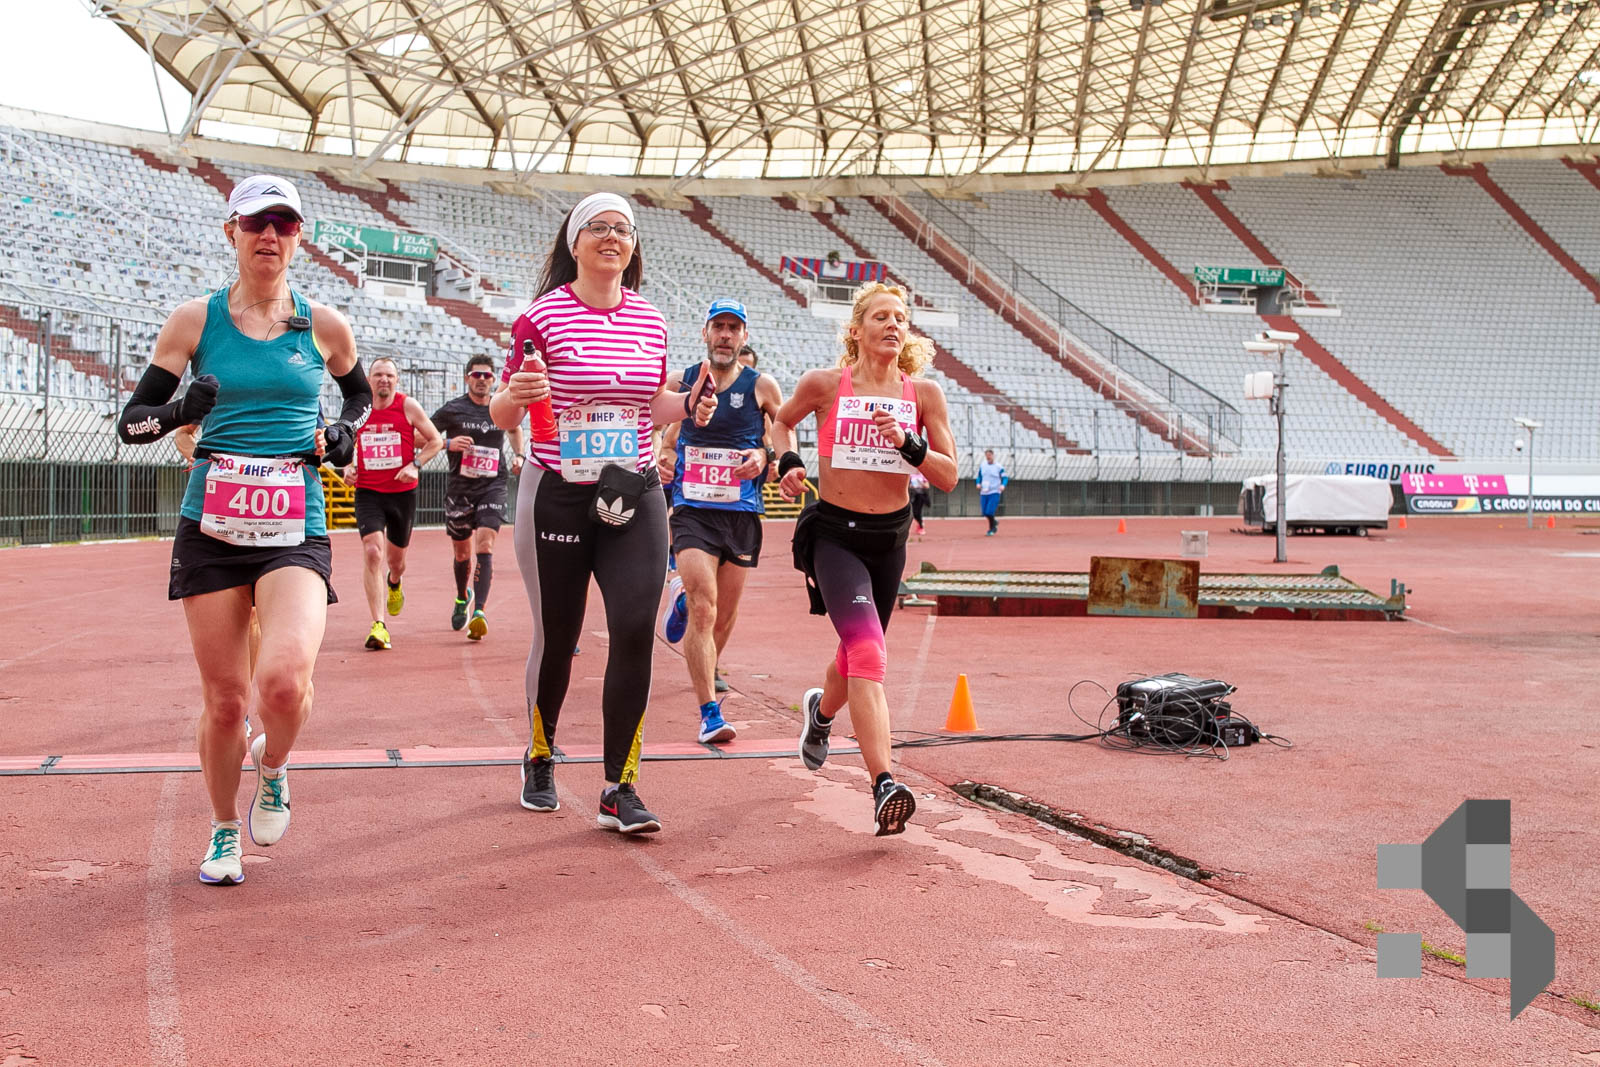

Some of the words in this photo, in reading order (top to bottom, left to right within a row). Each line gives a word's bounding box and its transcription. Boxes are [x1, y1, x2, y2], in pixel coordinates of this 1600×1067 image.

[404, 242, 428, 254] EXIT
[566, 409, 582, 421] 20
[596, 412, 615, 422] HEP
[620, 408, 635, 419] 20
[127, 416, 162, 436] sljeme
[575, 431, 634, 456] 1976
[372, 445, 394, 458] 151
[472, 457, 493, 470] 120
[251, 464, 274, 478] HEP
[699, 466, 732, 485] 184
[228, 486, 290, 517] 400
[1482, 498, 1491, 510] S
[1564, 499, 1582, 511] DO
[541, 556, 580, 568] LEGEA
